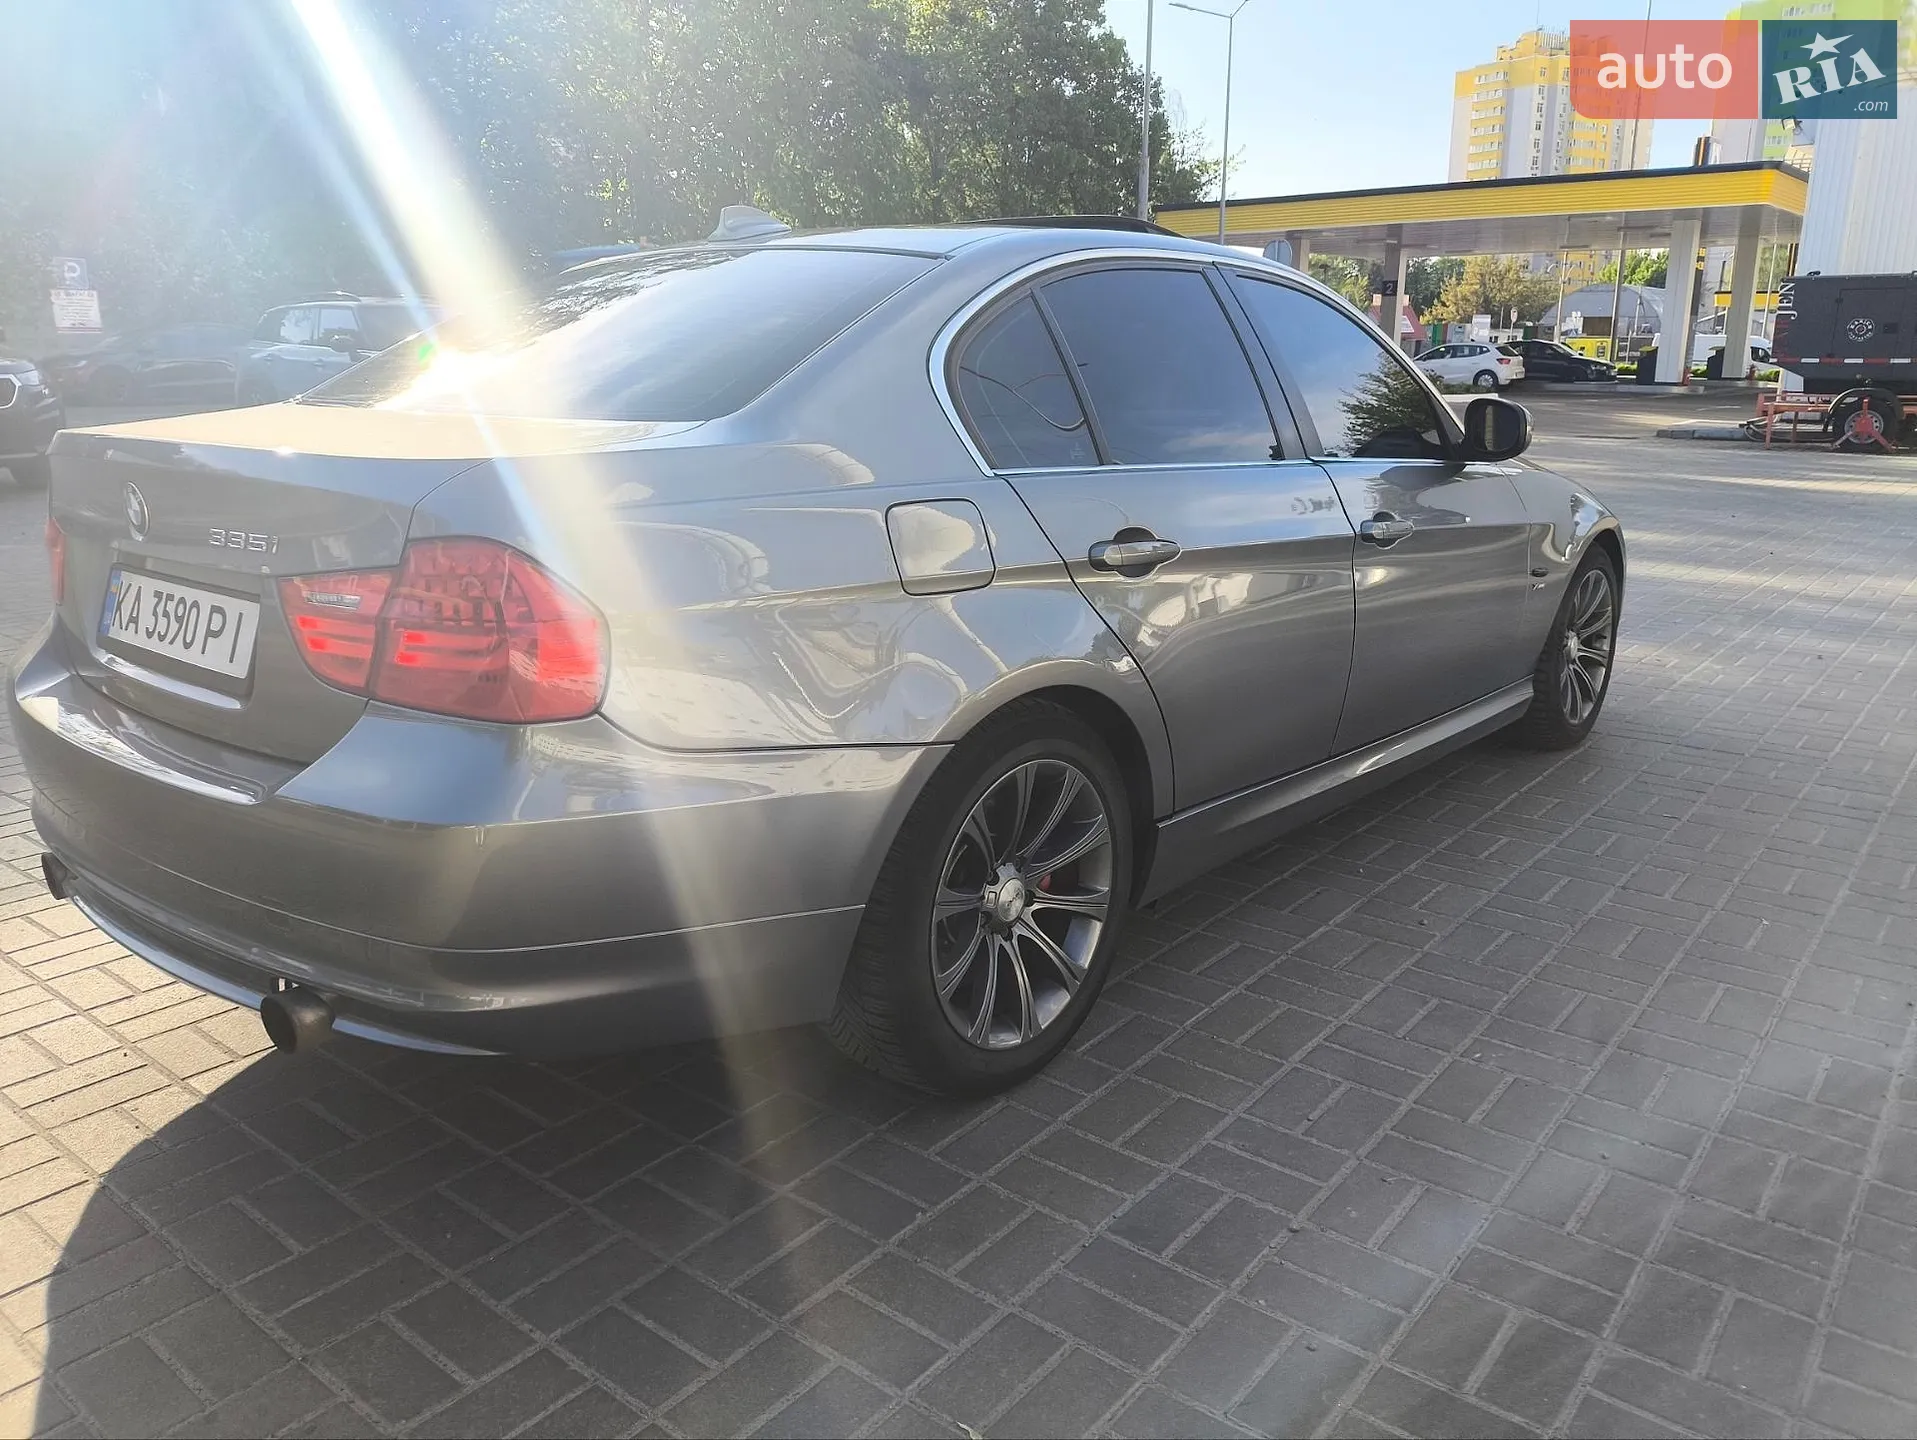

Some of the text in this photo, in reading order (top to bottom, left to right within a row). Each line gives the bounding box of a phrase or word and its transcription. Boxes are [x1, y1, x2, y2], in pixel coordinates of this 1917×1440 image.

[1385, 282, 1394, 295] 2
[209, 527, 280, 554] 335i
[112, 580, 243, 664] KA 3590 PI
